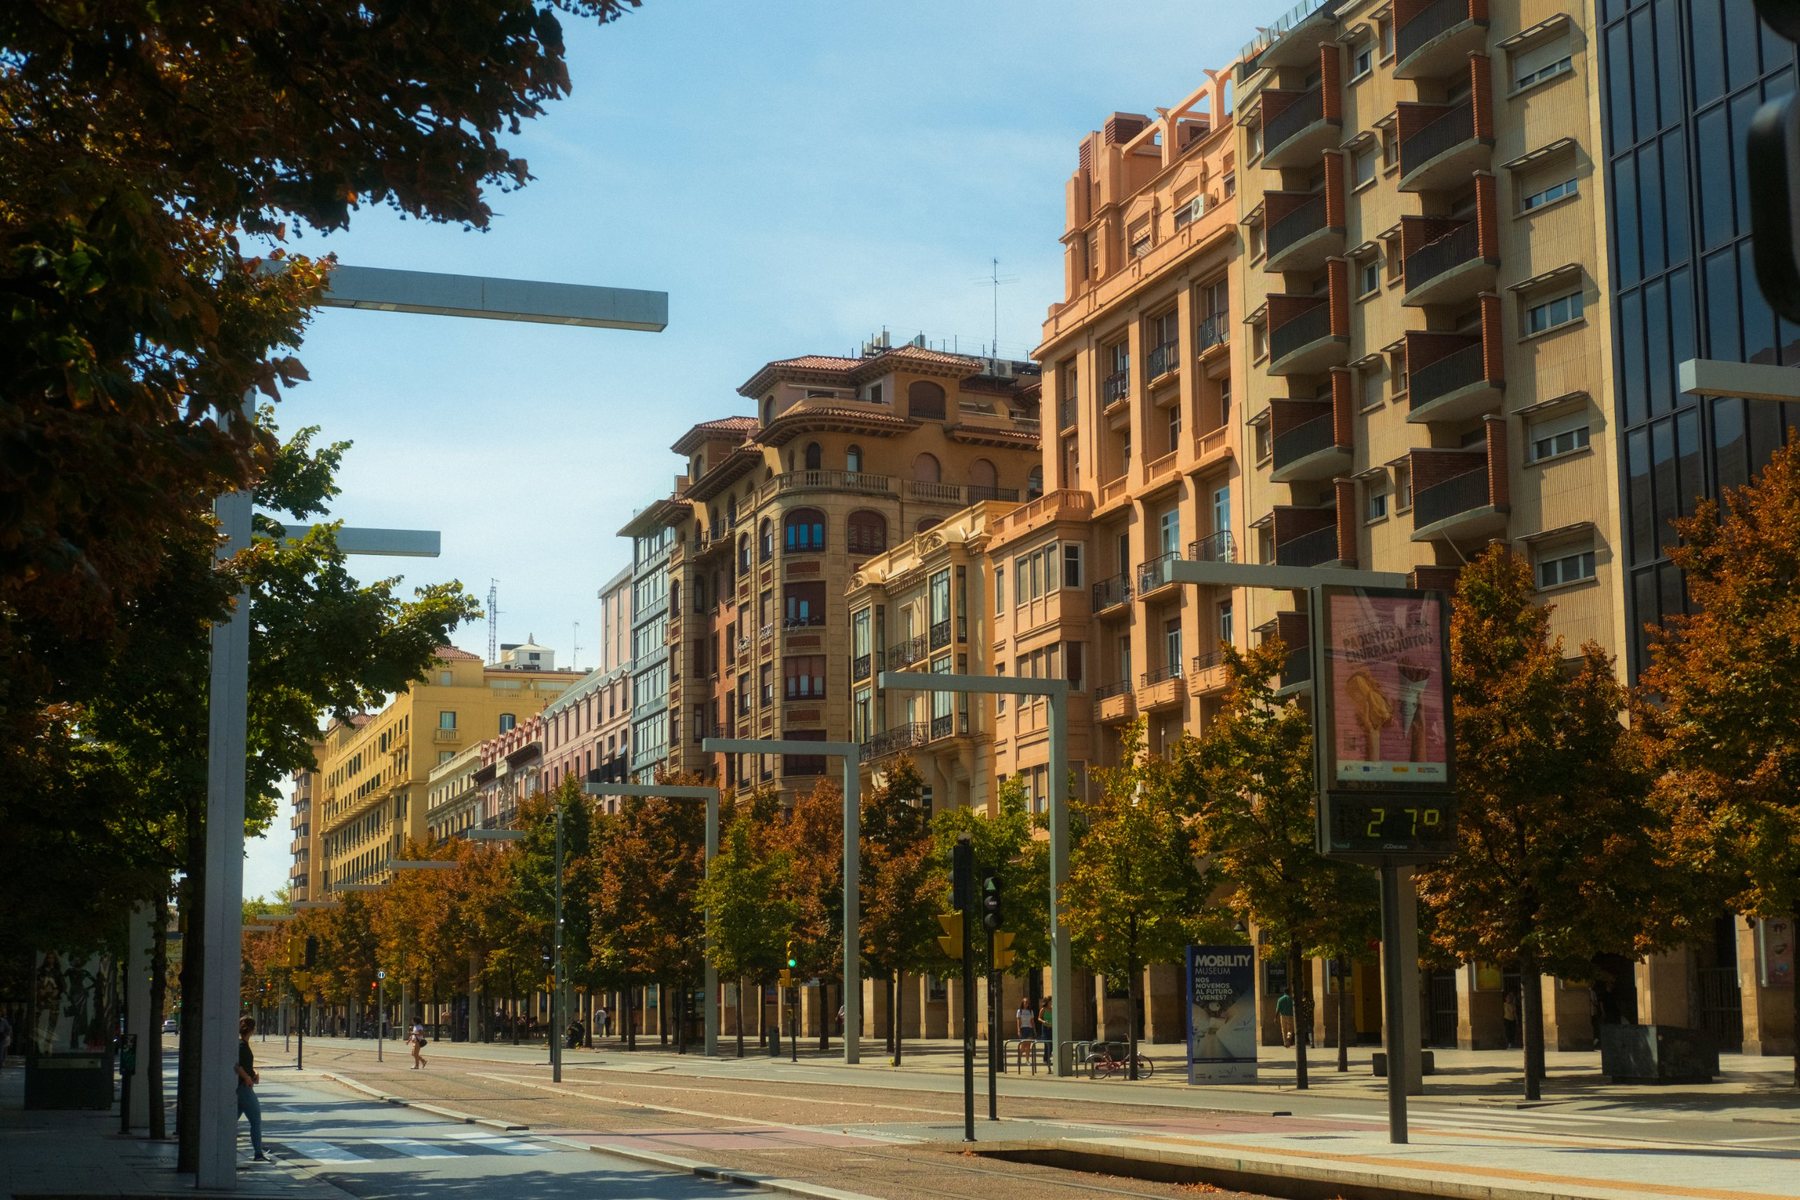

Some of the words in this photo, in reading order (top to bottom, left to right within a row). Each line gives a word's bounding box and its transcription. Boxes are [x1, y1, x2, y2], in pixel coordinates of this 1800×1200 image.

[1343, 629, 1395, 649] PAQUITOS
[1396, 626, 1404, 638] Y
[1195, 955, 1251, 967] MOBILITY
